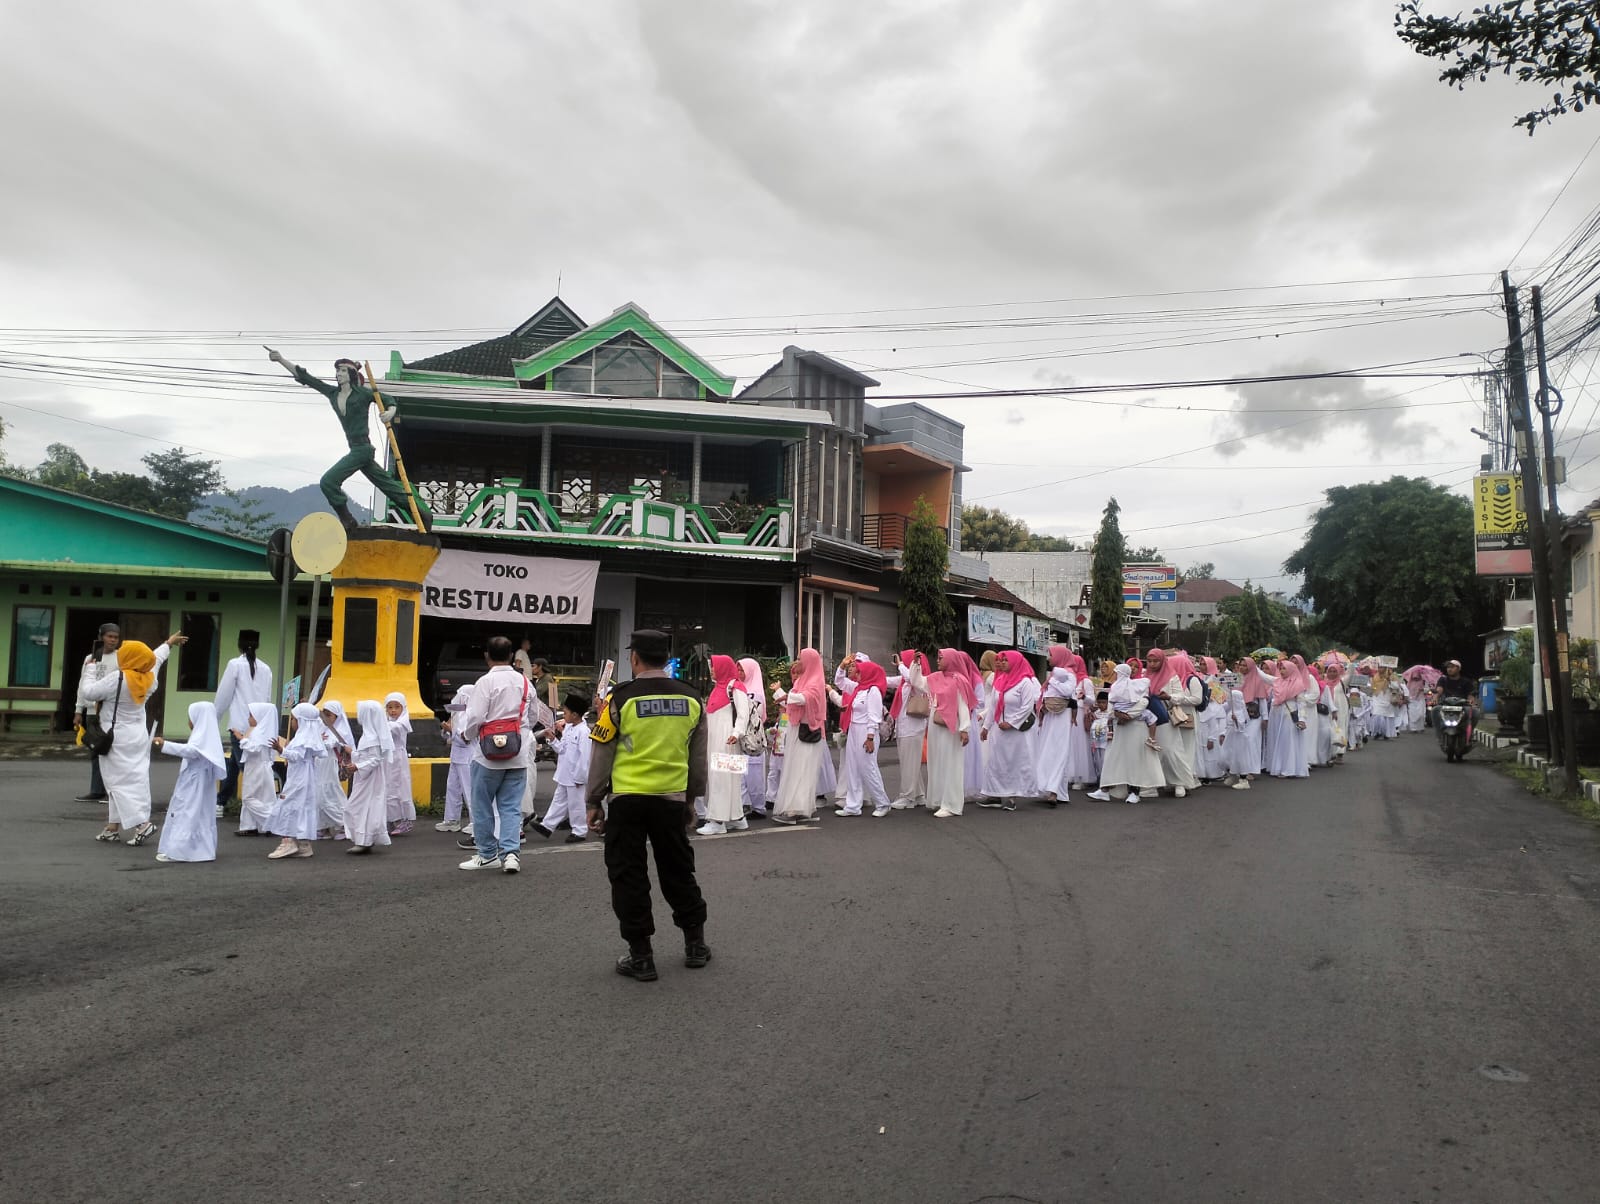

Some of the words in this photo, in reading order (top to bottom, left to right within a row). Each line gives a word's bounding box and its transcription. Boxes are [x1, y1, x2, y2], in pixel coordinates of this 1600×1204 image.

[484, 563, 528, 579] TOKO
[1124, 573, 1164, 581] Indomaret
[426, 586, 503, 611] RESTU
[507, 593, 579, 615] ABADI
[640, 700, 687, 715] POLISI
